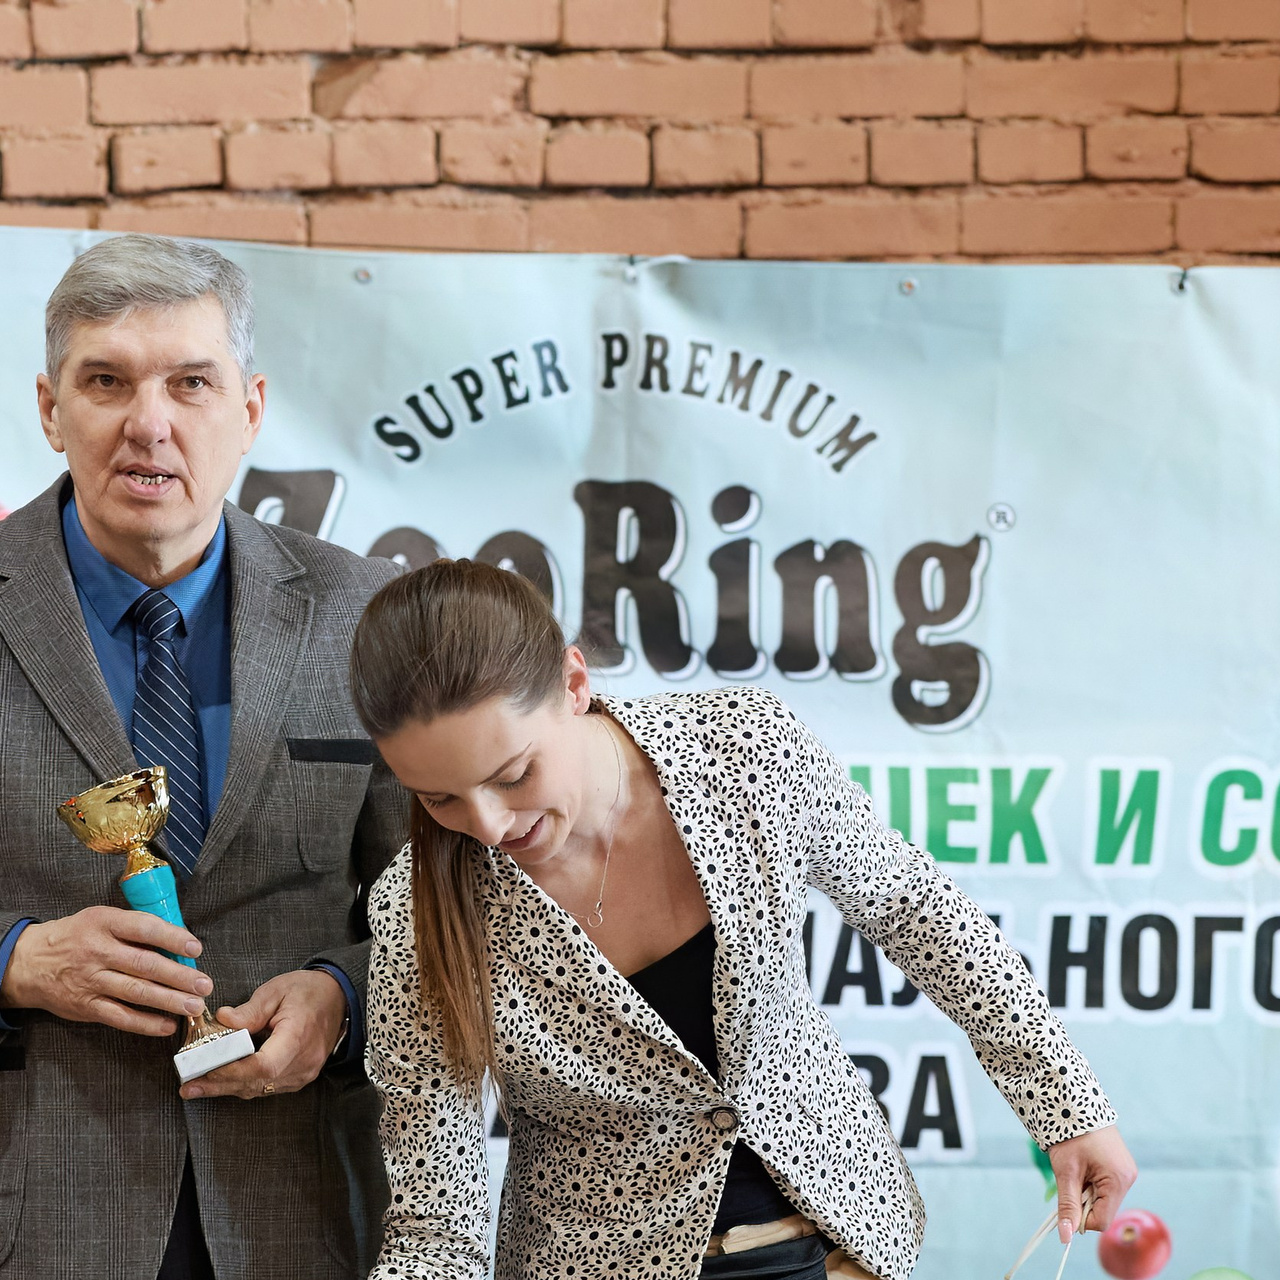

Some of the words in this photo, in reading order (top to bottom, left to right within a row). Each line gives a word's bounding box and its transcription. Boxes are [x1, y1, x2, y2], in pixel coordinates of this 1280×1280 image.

[374, 339, 571, 464] SUPER
[600, 333, 878, 473] PREMIUM
[1095, 768, 1160, 866] И
